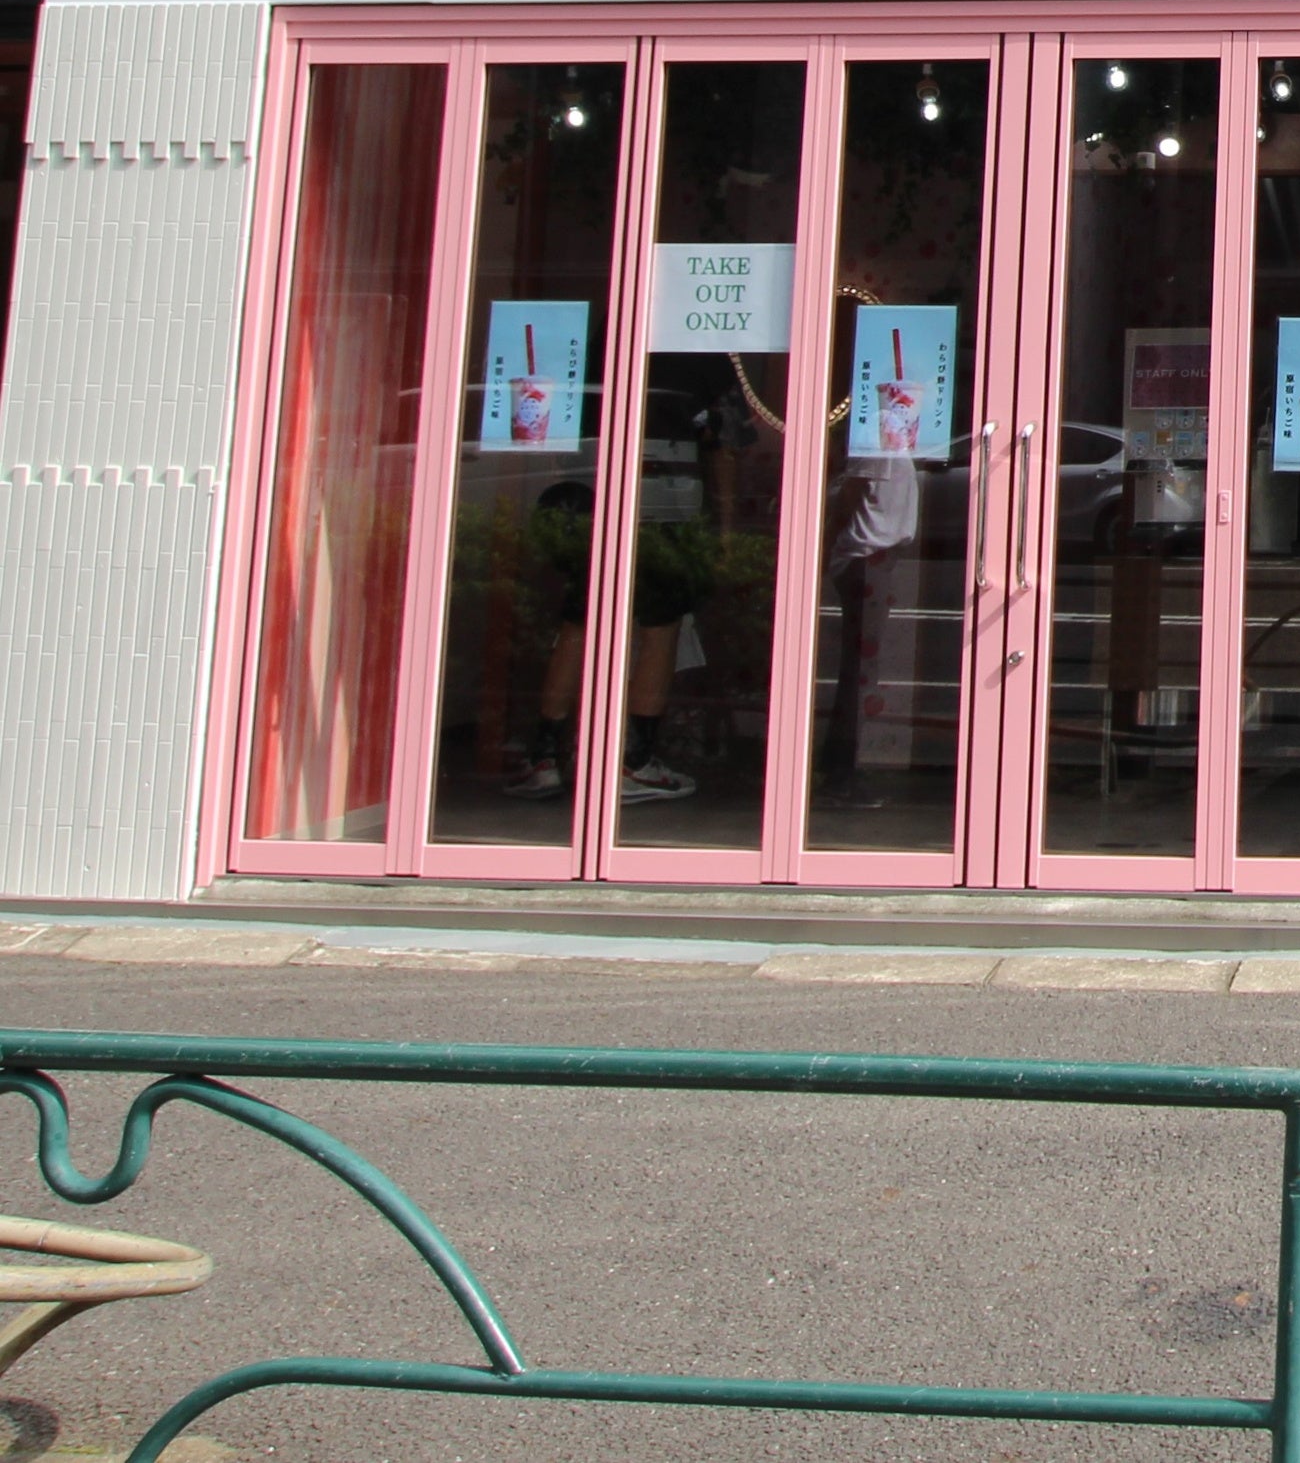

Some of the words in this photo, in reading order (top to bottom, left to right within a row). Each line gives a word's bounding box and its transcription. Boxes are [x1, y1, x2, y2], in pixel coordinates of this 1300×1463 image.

[687, 257, 751, 276] TAKE
[696, 284, 746, 303] OUT
[686, 312, 753, 331] ONLY
[1180, 368, 1210, 378] ONL
